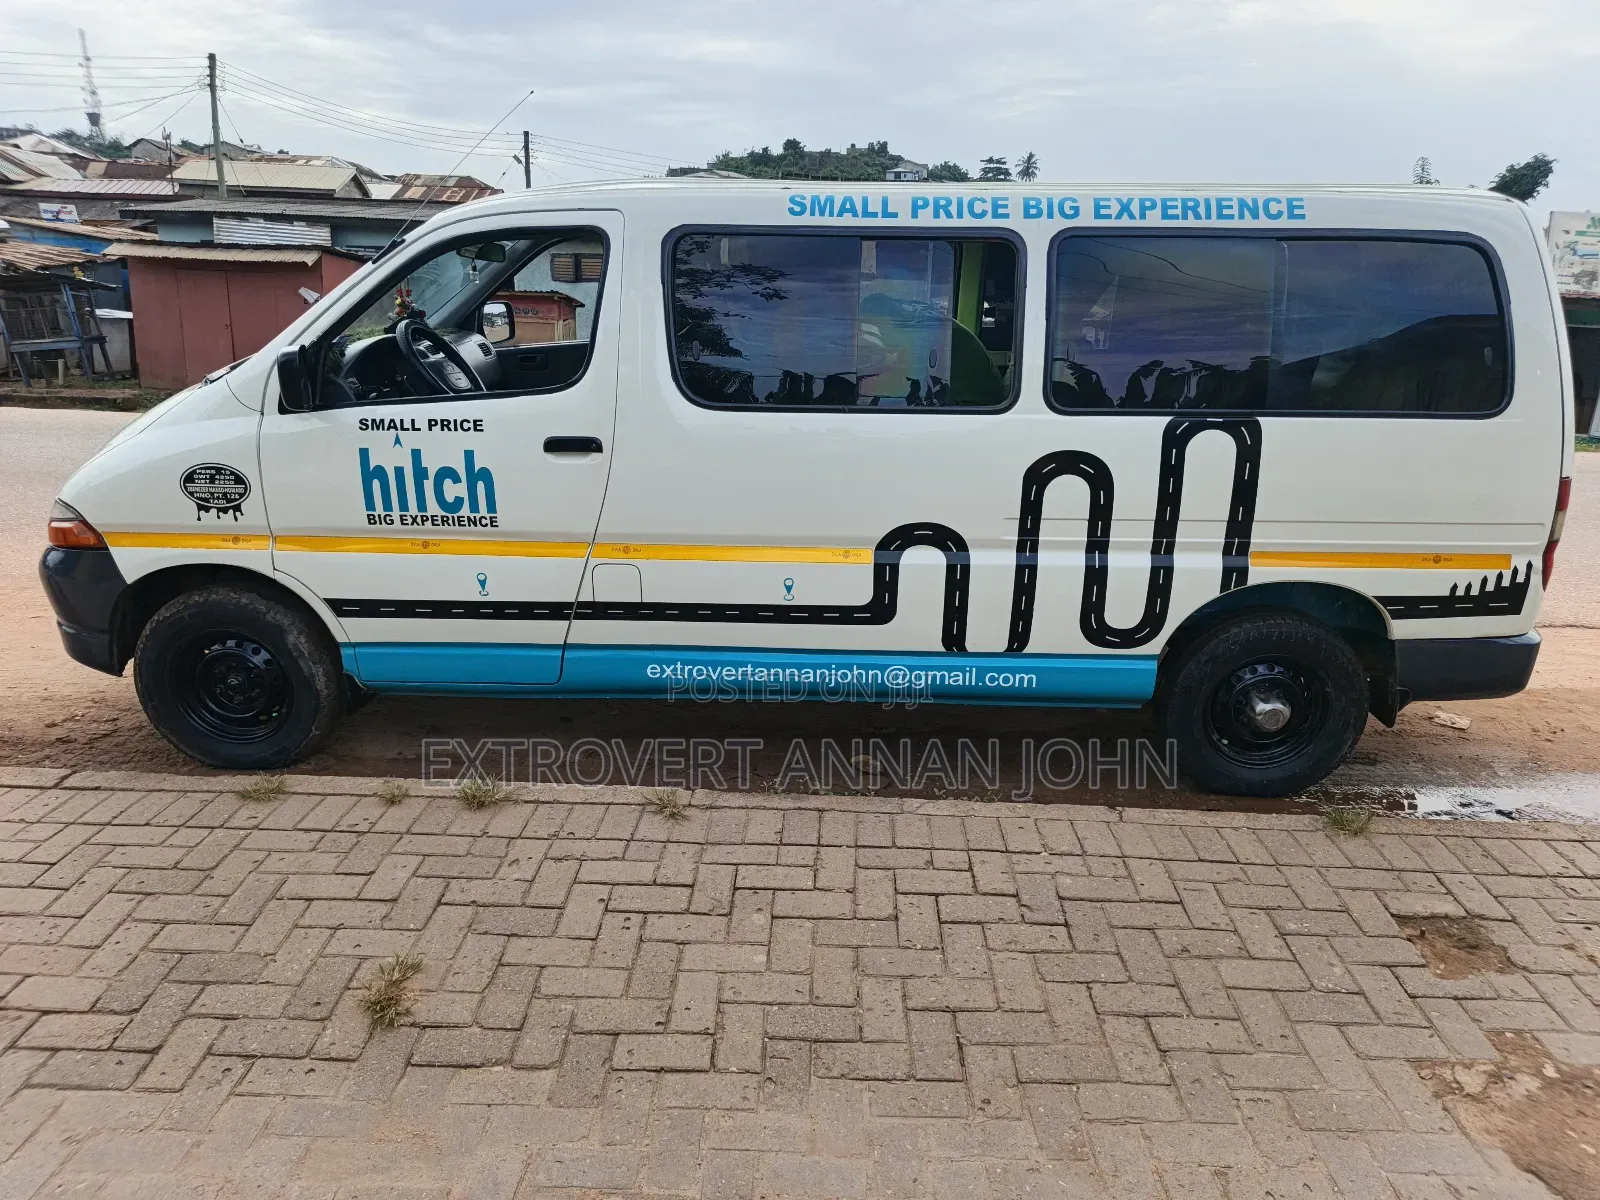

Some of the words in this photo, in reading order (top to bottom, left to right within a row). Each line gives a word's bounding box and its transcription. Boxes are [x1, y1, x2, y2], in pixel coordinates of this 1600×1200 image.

[788, 194, 899, 220] SMALL
[911, 195, 1010, 220] PRICE
[1022, 196, 1080, 221] BIG
[1092, 197, 1307, 221] EXPERIENCE
[358, 418, 422, 431] SMALL
[427, 418, 484, 432] PRICE
[358, 447, 498, 515] hitch
[367, 513, 395, 526] BIG
[399, 514, 499, 528] EXPERIENCE
[646, 661, 1037, 688] extrovertannanjohn@gmail.com
